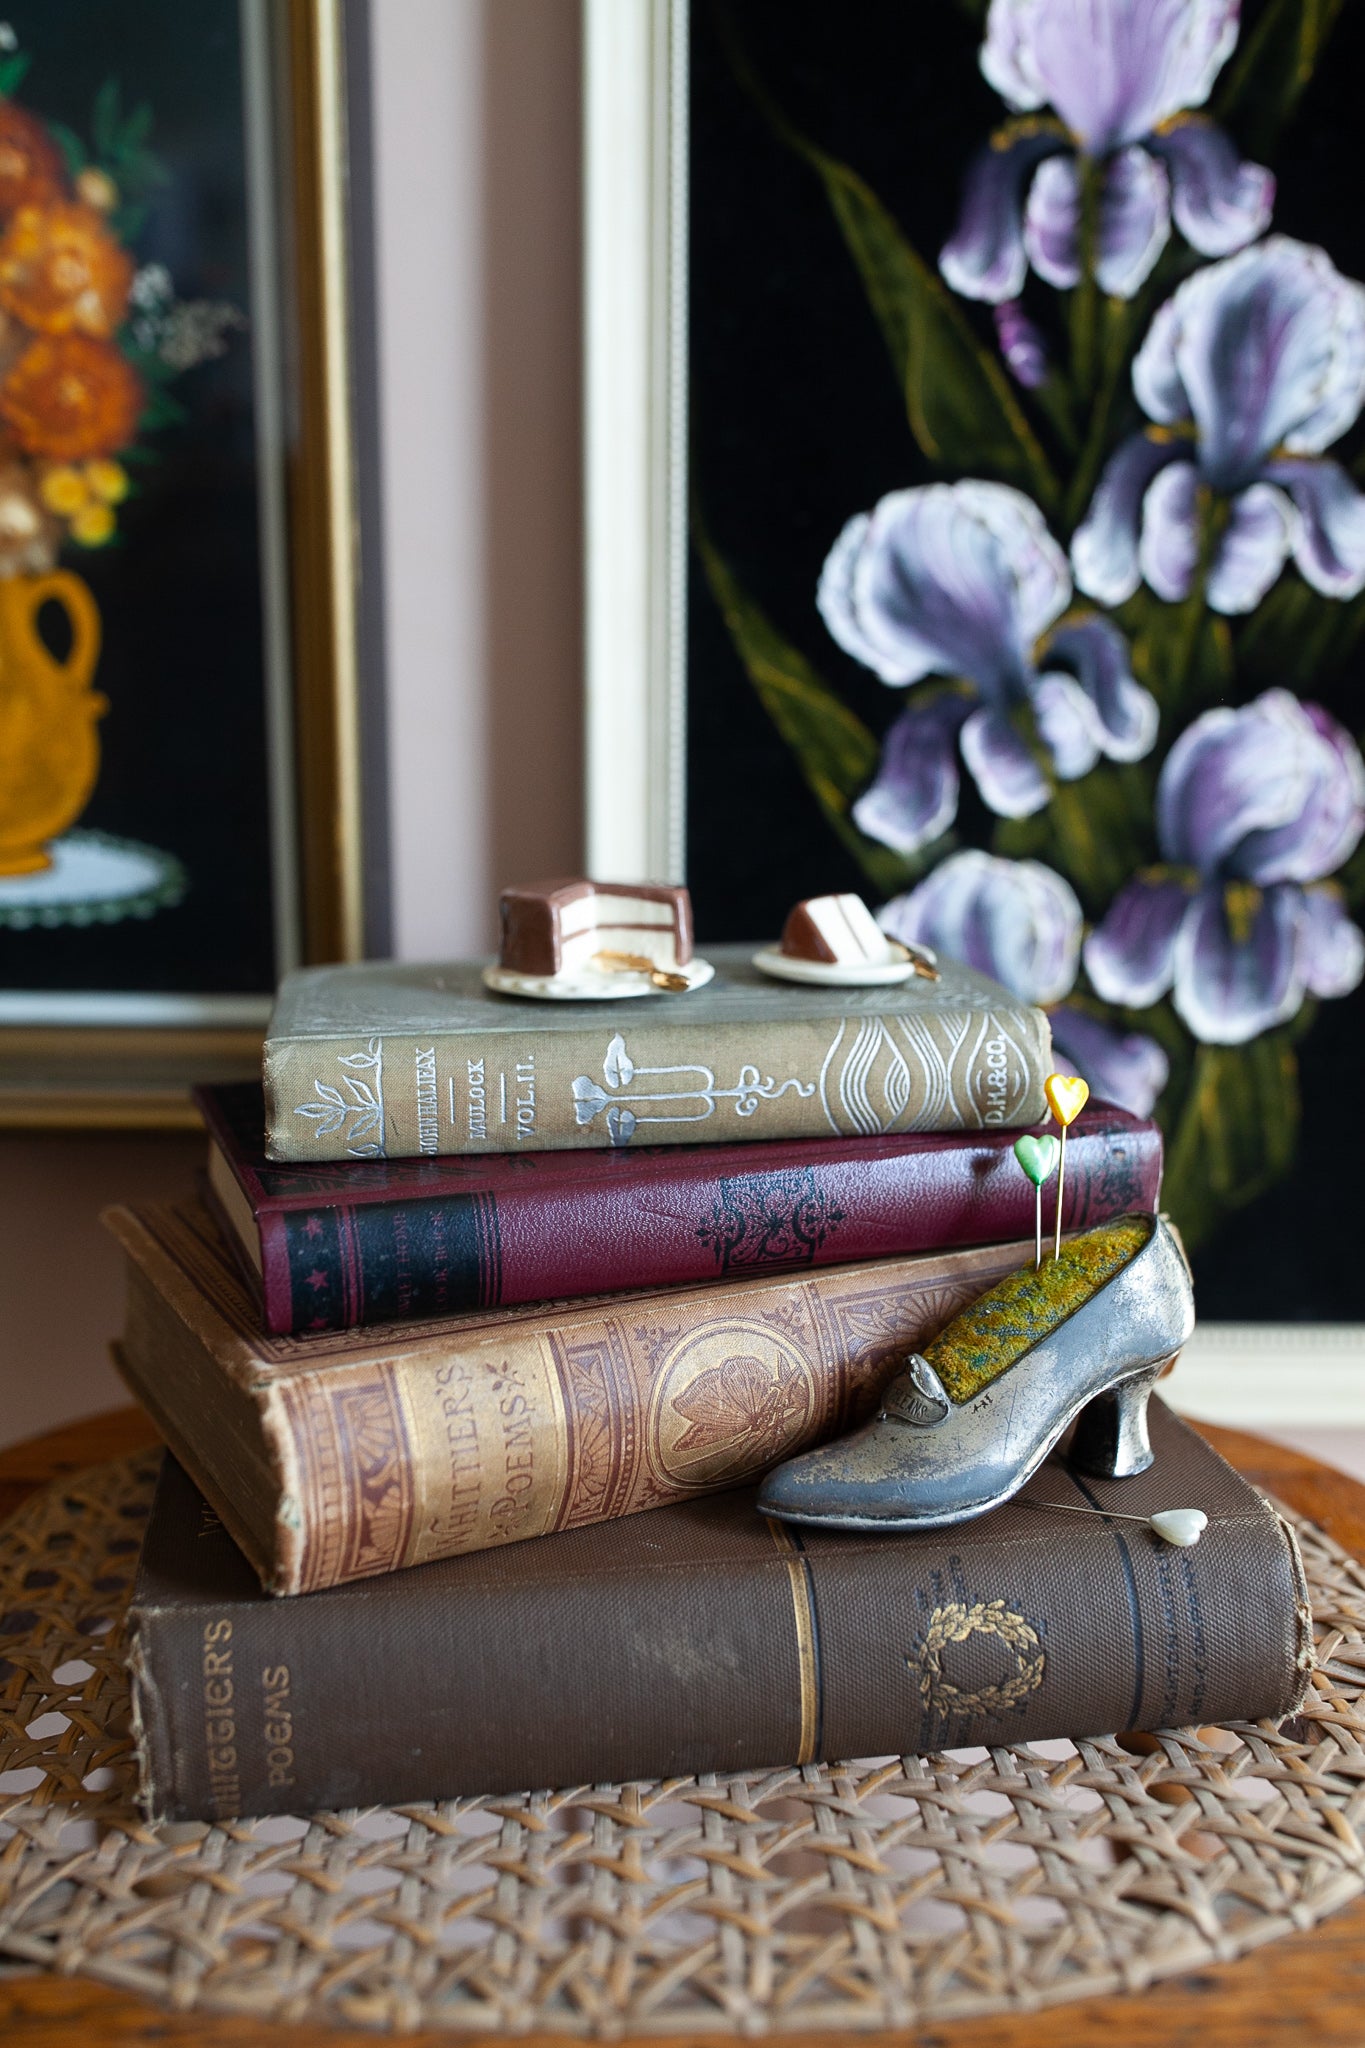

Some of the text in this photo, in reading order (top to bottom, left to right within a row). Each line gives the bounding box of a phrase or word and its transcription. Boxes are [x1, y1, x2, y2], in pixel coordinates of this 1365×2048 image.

[416, 1046, 439, 1155] JOHN HALIFAX
[467, 1058, 487, 1139] MULOCK
[426, 1363, 482, 1559] WHITTIER'S
[489, 1394, 536, 1520] POEMS
[262, 1664, 296, 1788] POEMS
